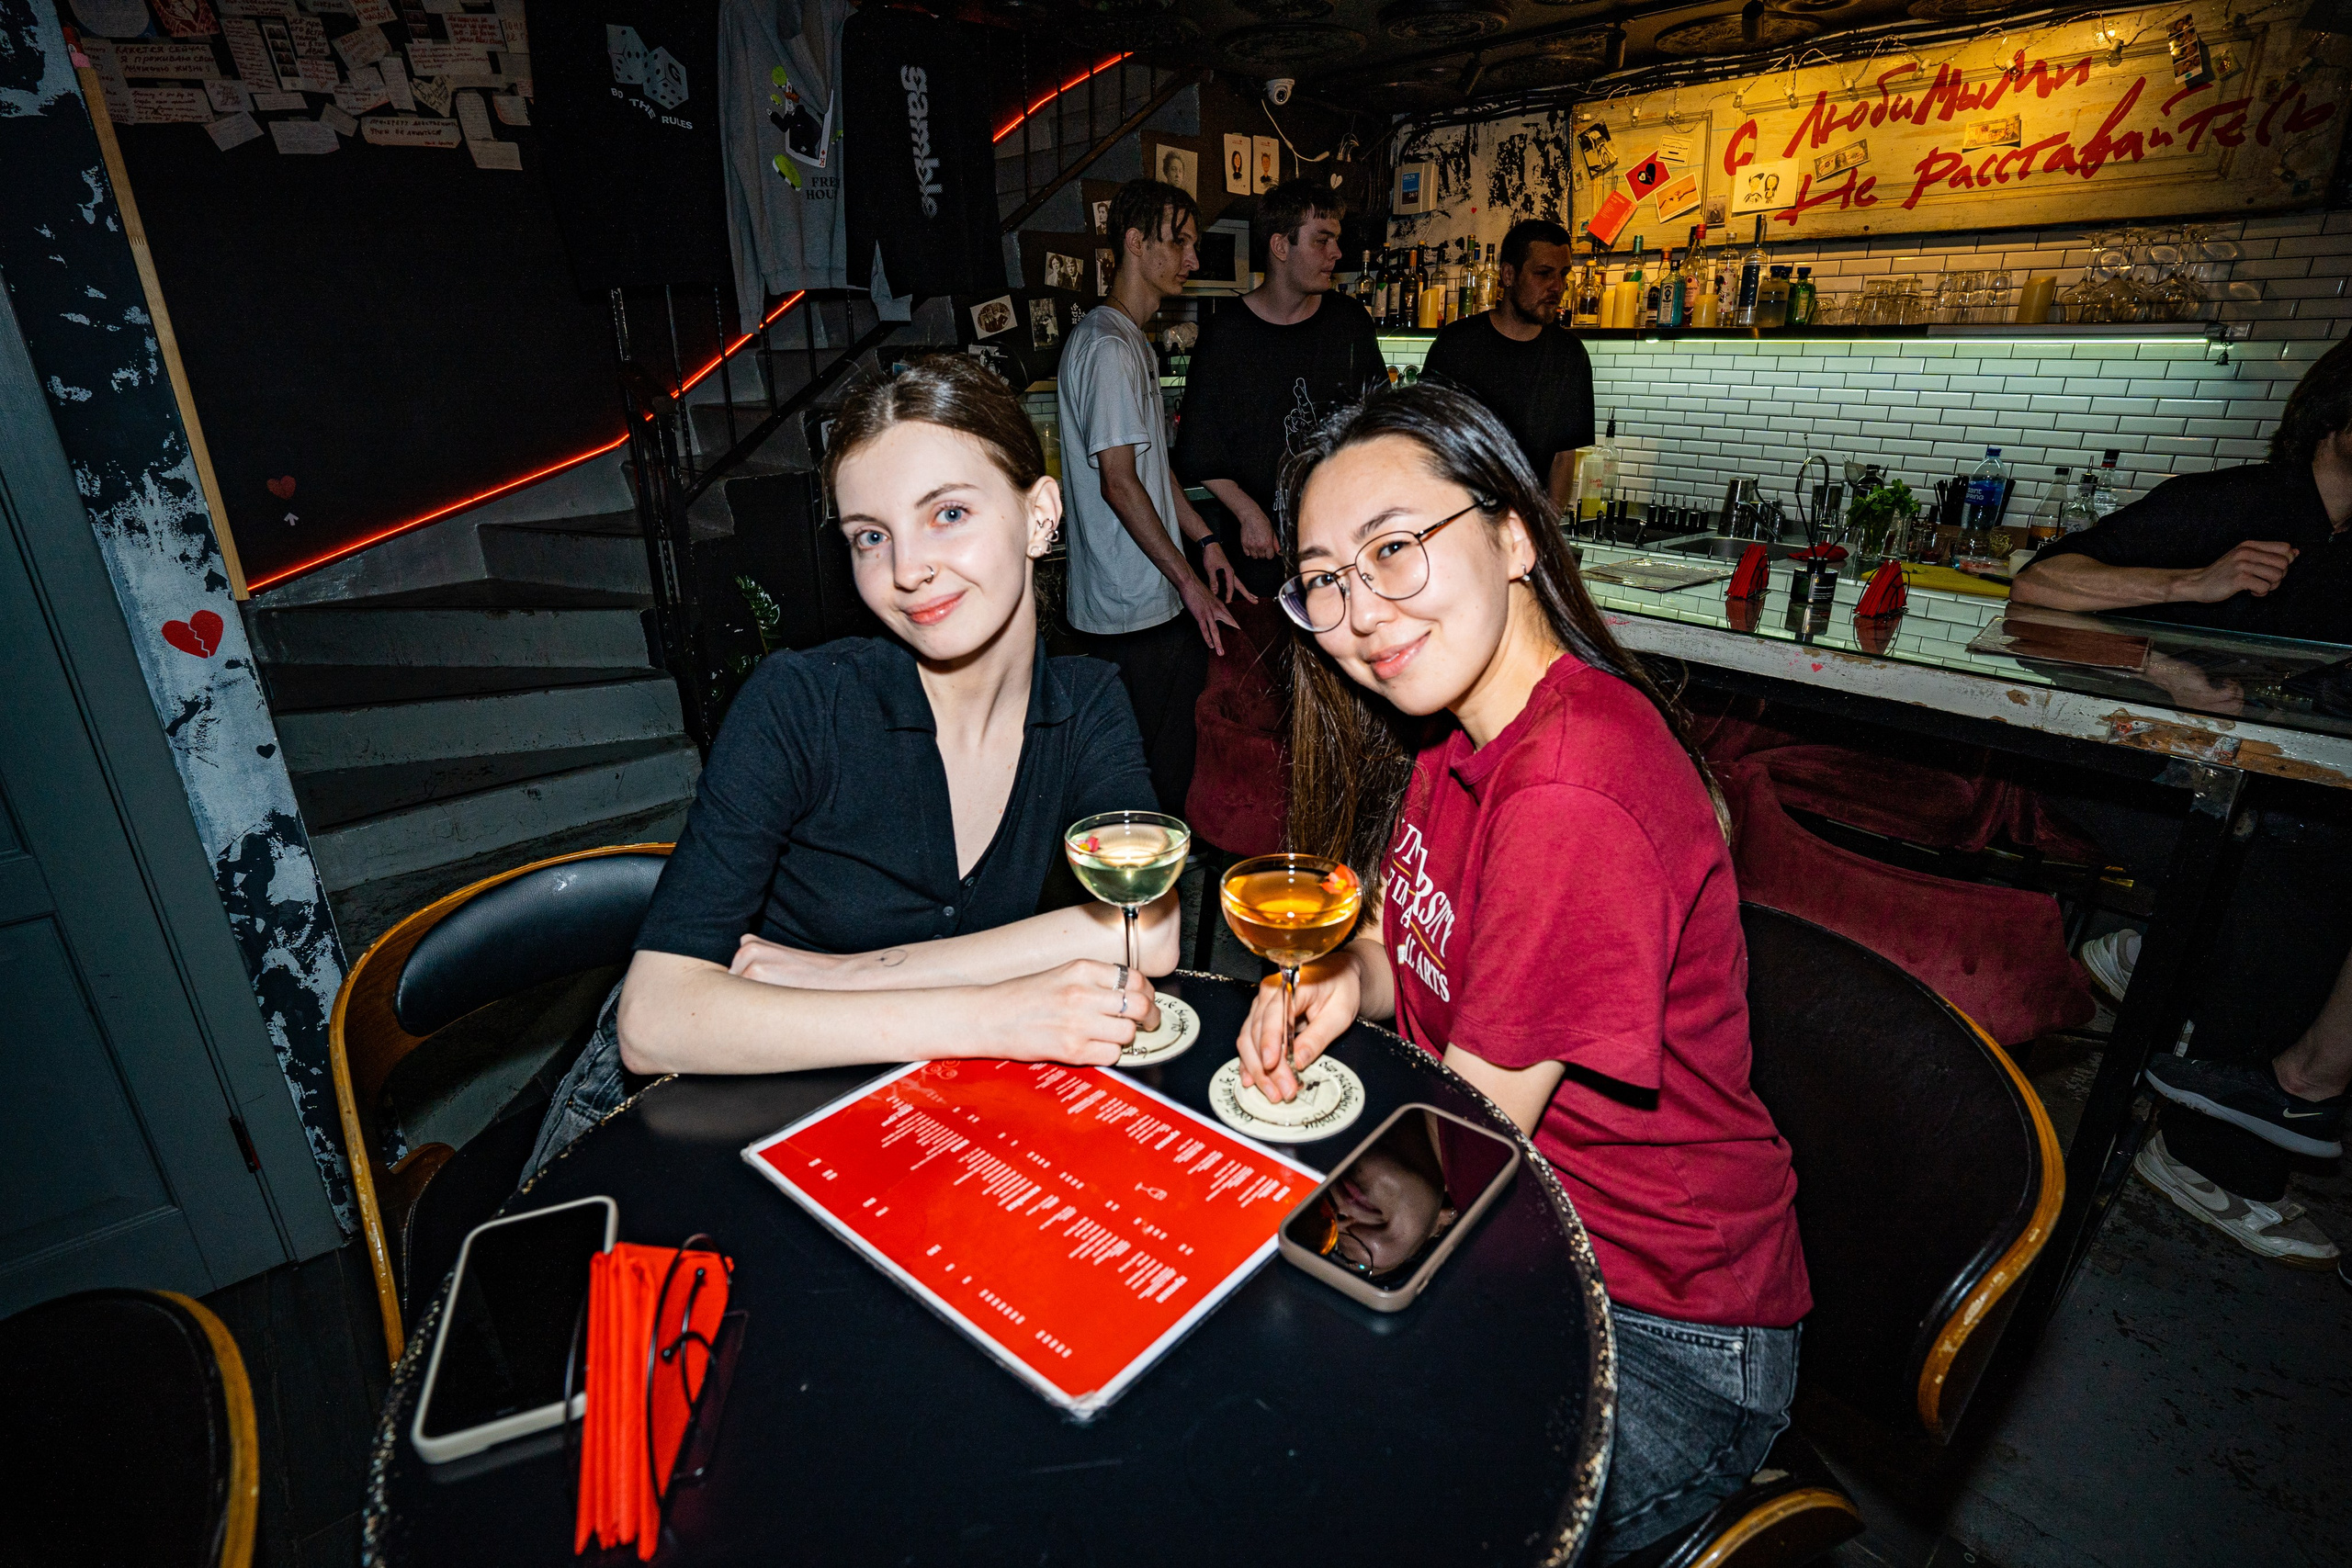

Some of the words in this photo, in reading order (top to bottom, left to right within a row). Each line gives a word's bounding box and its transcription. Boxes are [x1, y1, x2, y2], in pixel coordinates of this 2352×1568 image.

[115, 45, 164, 54] КАЖЕТСЯ
[168, 45, 208, 53] СЕЙЧАС
[120, 55, 128, 63] Я
[628, 98, 657, 119] THE
[661, 115, 694, 130] RULES
[1416, 951, 1451, 1003] ARTS
